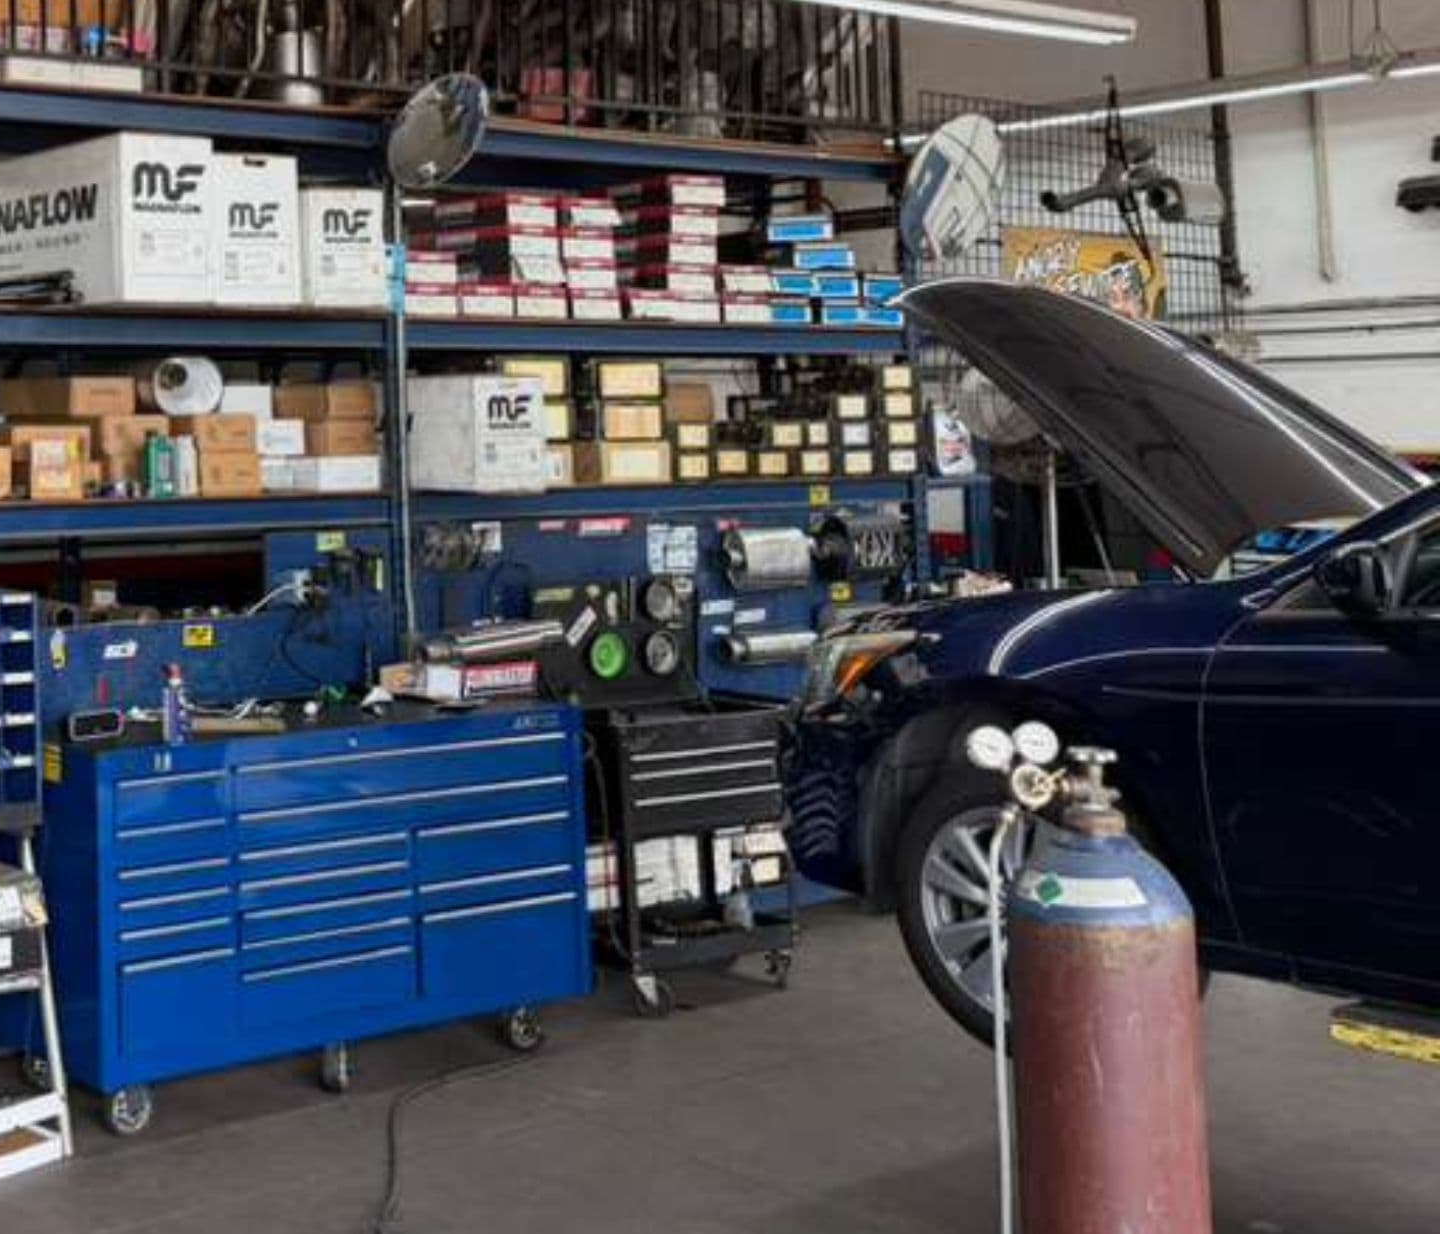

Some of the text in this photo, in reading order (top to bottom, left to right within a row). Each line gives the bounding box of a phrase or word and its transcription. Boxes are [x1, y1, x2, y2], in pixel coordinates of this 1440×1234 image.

[133, 162, 205, 200] MF
[229, 203, 279, 229] MF
[323, 209, 372, 234] MF
[488, 395, 532, 420] MF
